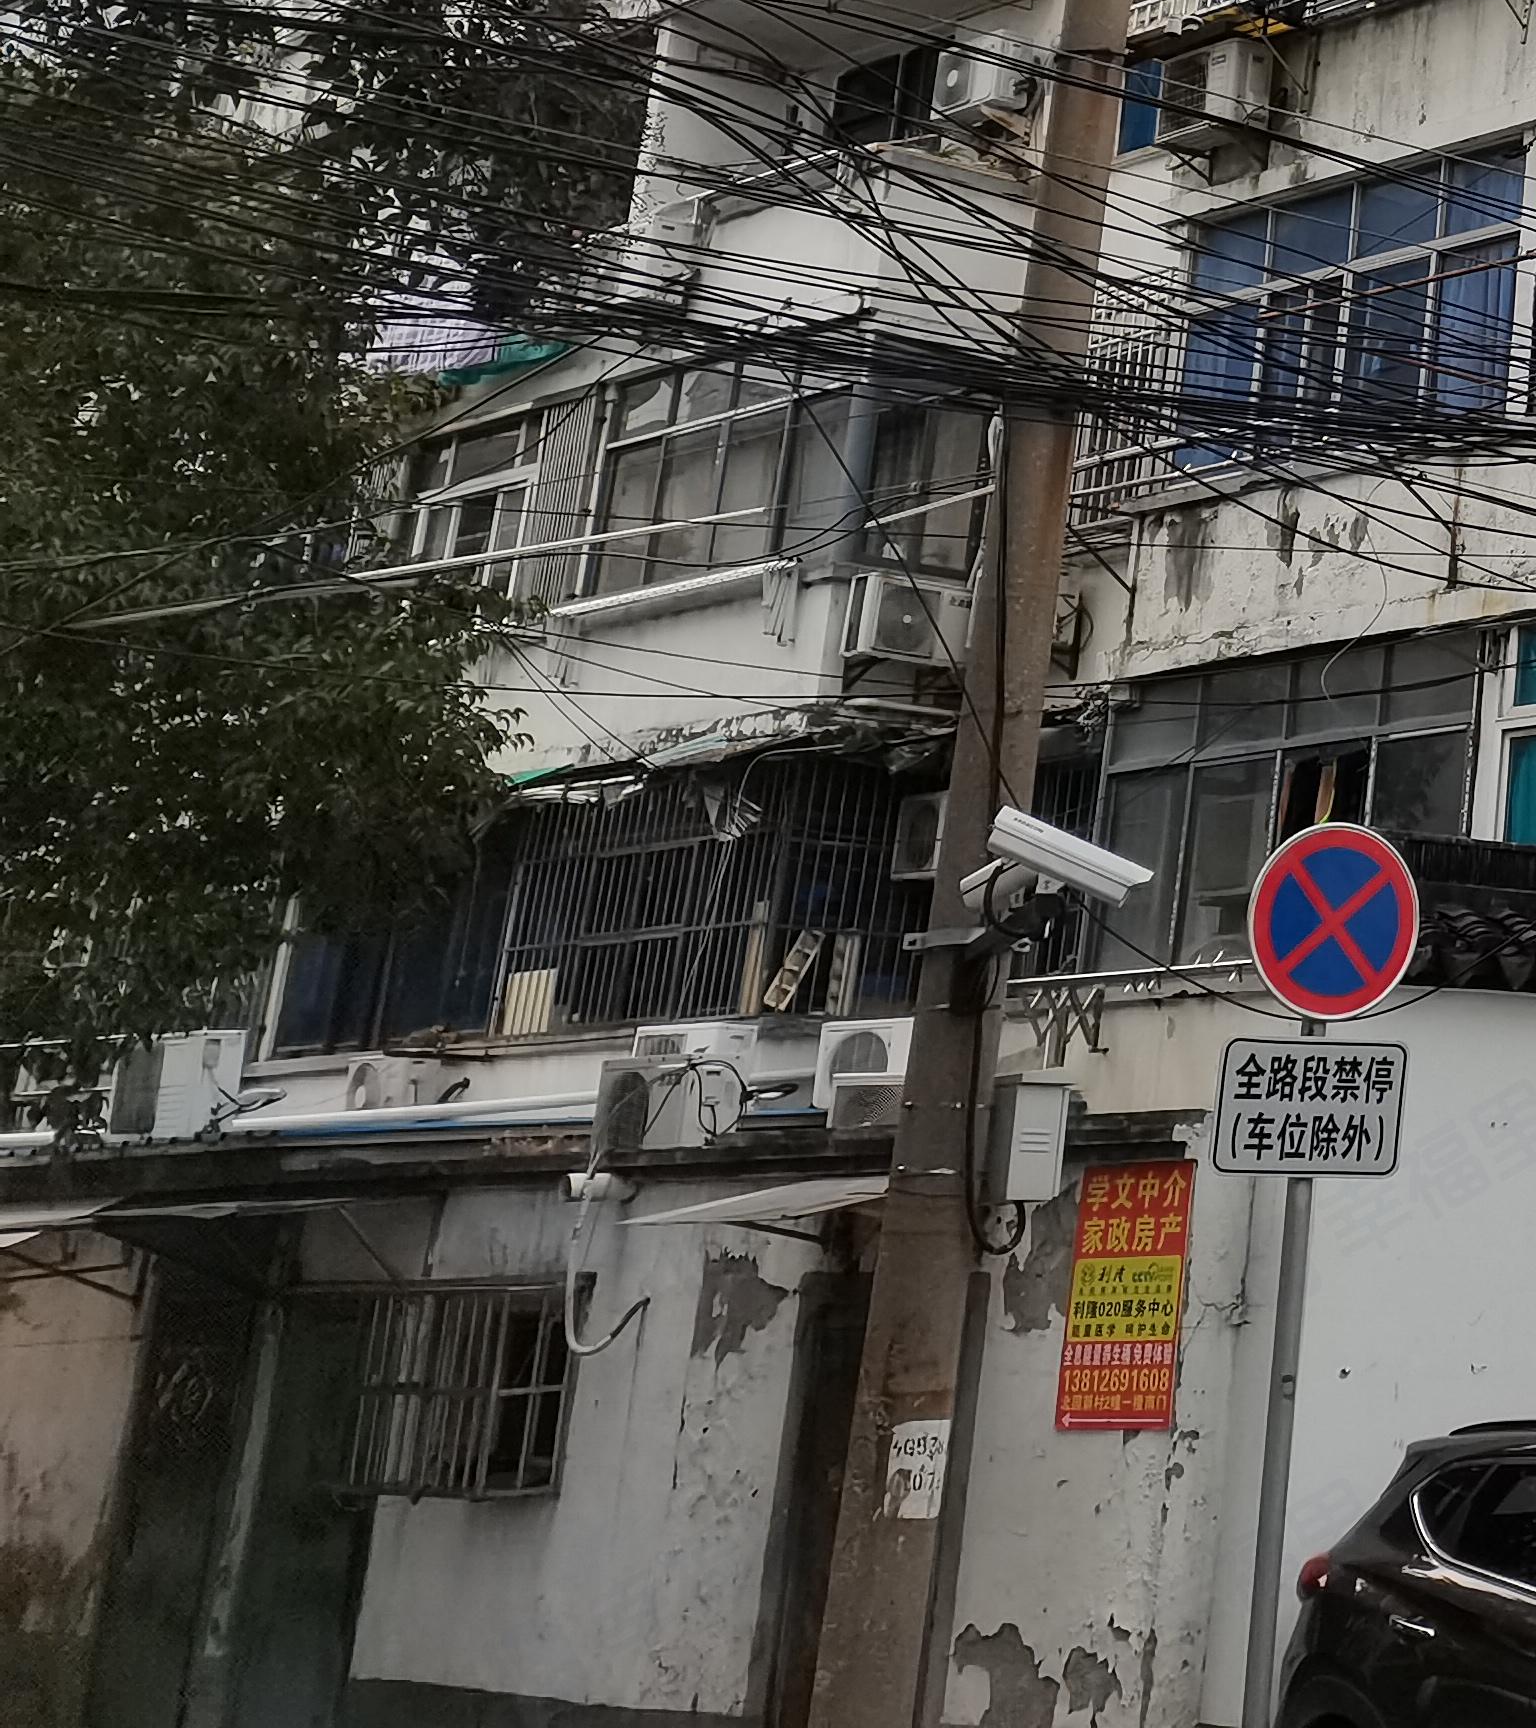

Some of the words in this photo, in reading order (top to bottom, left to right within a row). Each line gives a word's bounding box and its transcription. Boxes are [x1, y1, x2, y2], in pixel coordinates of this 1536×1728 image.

[1233, 1053, 1395, 1105] 全路段禁停
[1231, 1112, 1385, 1162] (车位除外)
[1086, 1169, 1187, 1212] 学文中介
[1081, 1212, 1183, 1254] 家政房产
[1064, 1368, 1169, 1393] 13812691608
